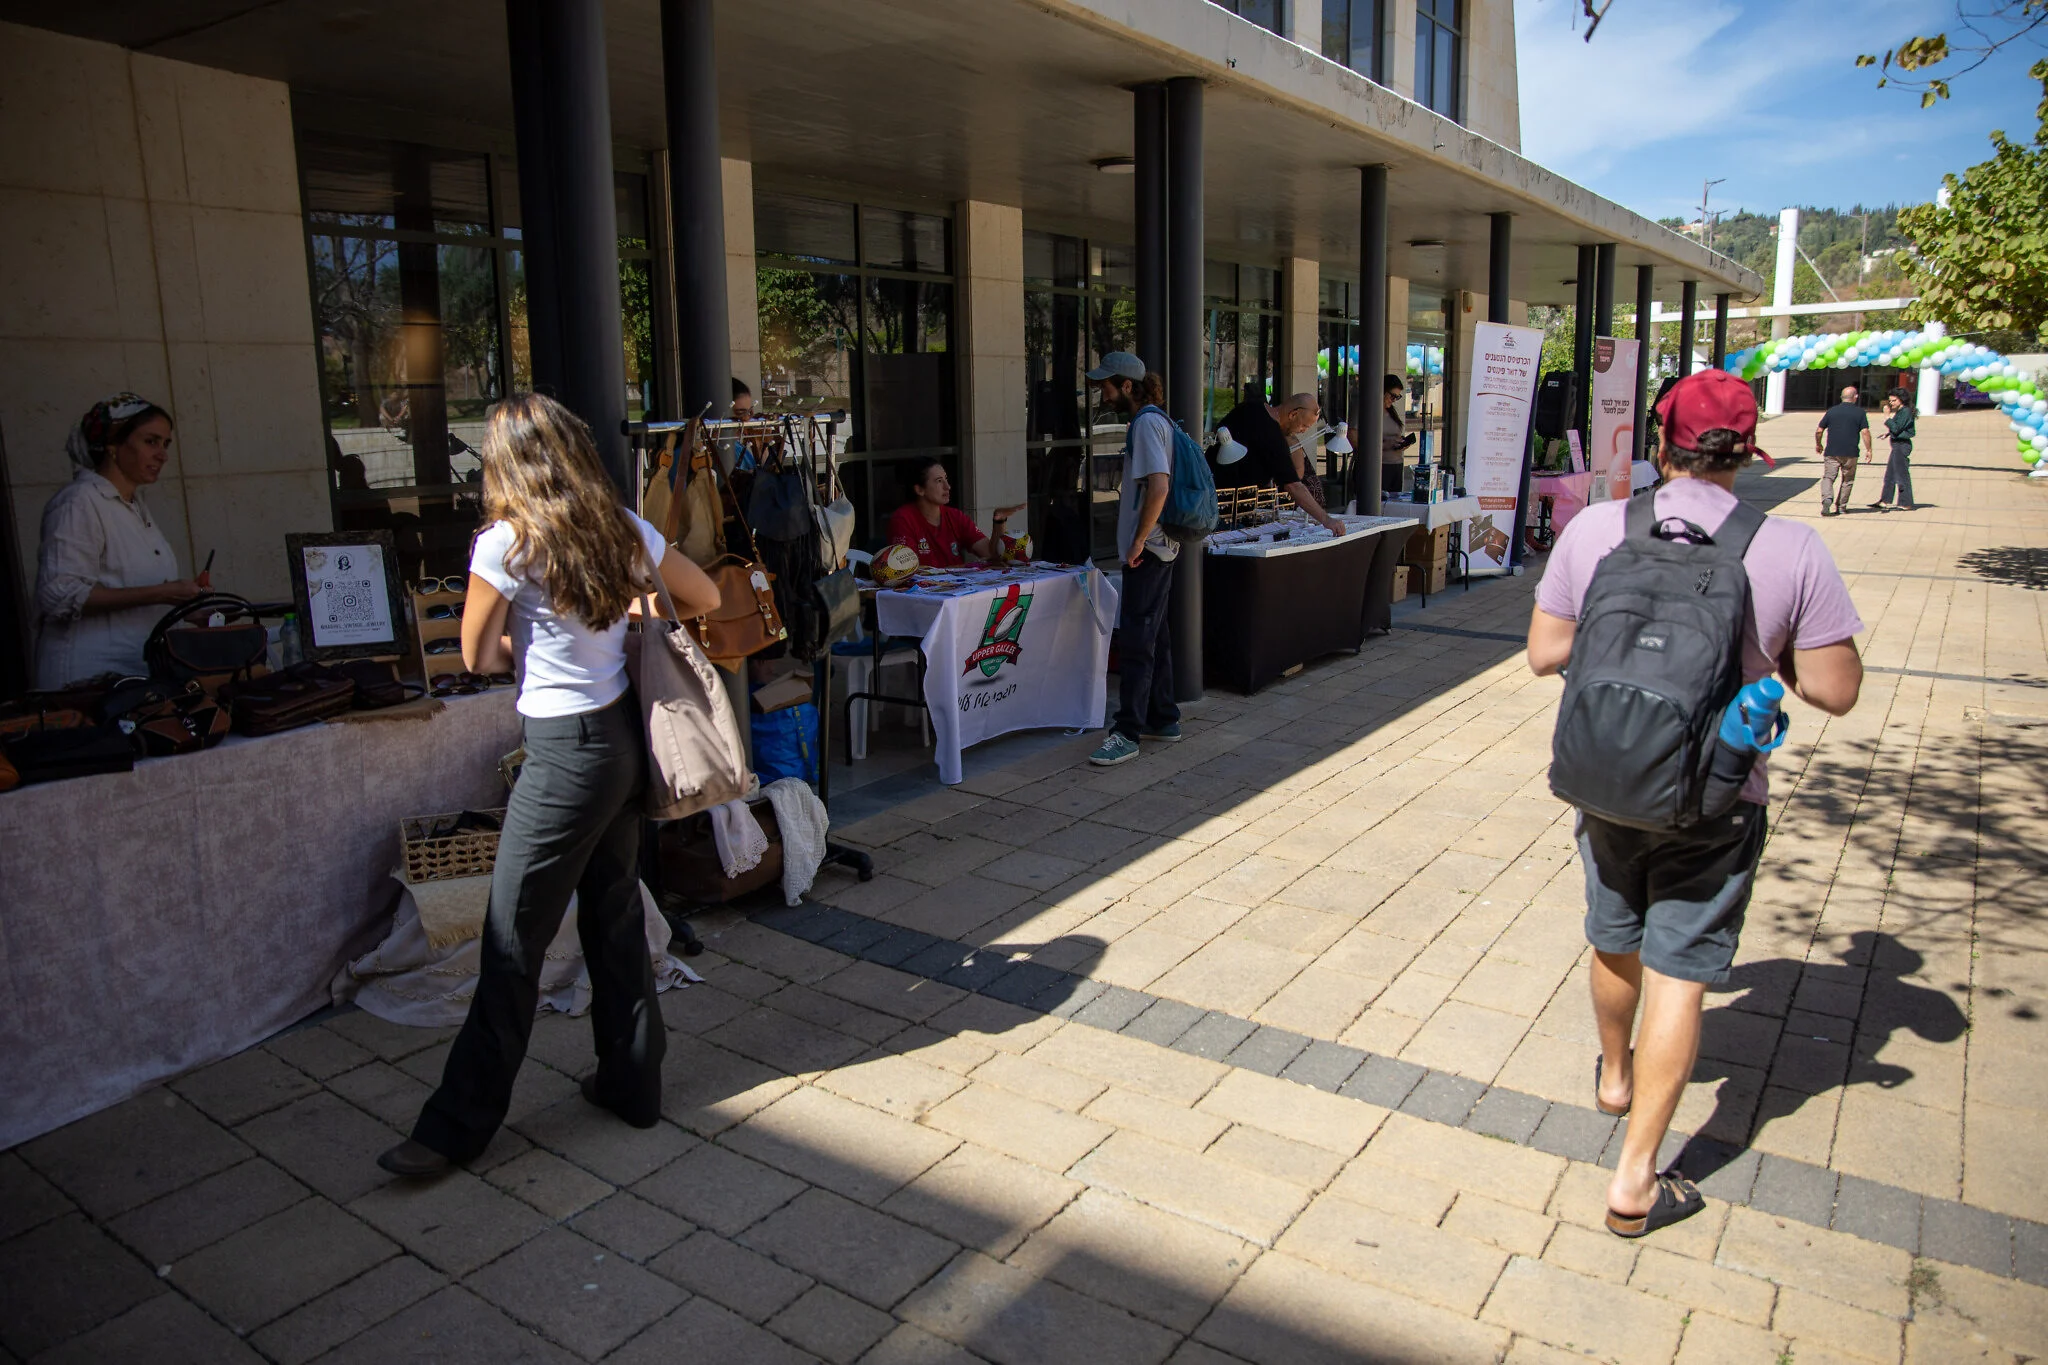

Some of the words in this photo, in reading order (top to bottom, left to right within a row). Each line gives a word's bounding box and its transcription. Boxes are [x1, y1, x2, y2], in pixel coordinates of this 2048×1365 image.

[1484, 352, 1506, 363] הנטענים
[1507, 355, 1531, 366] הכרטיסים
[1519, 368, 1528, 377] של
[972, 646, 995, 661] UPPER
[995, 643, 1017, 655] GALILEE
[992, 683, 1017, 702] רוגבי
[973, 691, 991, 709] גליל
